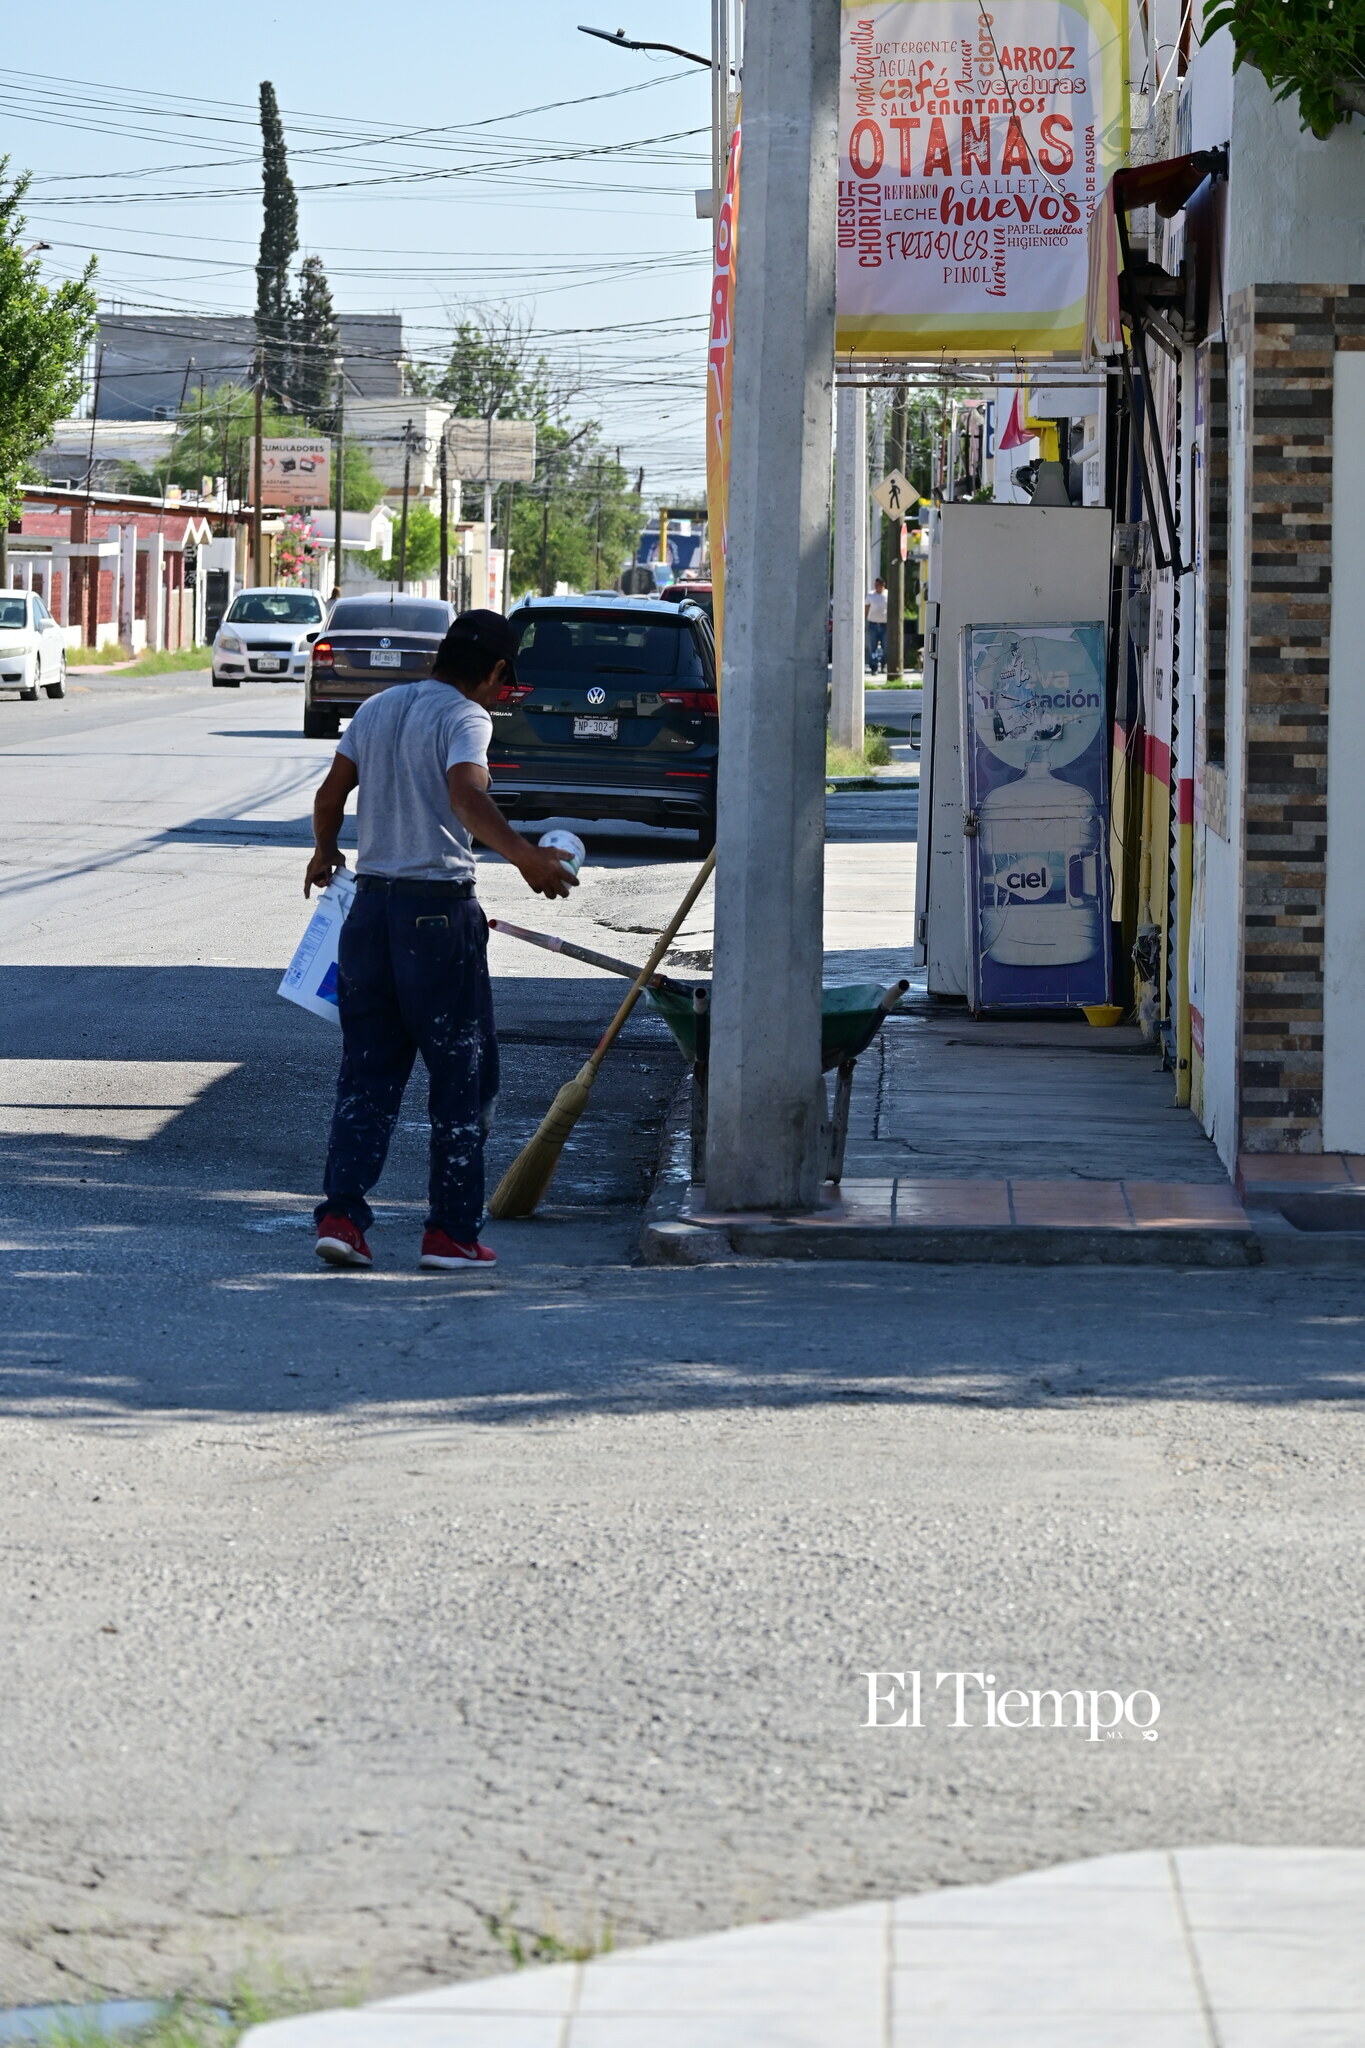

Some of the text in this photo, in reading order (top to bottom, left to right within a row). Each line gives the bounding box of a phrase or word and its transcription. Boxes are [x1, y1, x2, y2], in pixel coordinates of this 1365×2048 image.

[875, 41, 958, 54] DETERGENTE
[974, 13, 994, 76] cloro
[850, 19, 881, 116] mantequilla
[879, 59, 916, 77] AGUA
[954, 39, 974, 94] Azucar
[999, 45, 1076, 73] ARROZ
[880, 59, 950, 112] café
[977, 75, 1087, 95] verduras
[881, 103, 907, 116] SAL
[849, 114, 1074, 179] OTANAS
[1085, 125, 1095, 173] BASURA
[884, 184, 938, 200] REFRESCO
[961, 178, 1066, 194] GALLETAS
[1085, 177, 1095, 192] DE
[884, 208, 937, 220] LECHE
[940, 186, 1081, 226] huevos
[838, 197, 856, 248] QUESO
[858, 183, 882, 267] CHORIZO
[1007, 225, 1042, 235] PAPEL
[886, 230, 989, 261] FRIJOLES
[985, 225, 1006, 297] harina
[943, 266, 991, 284] PINOL
[976, 689, 1100, 710] itación
[1006, 867, 1046, 888] ciel
